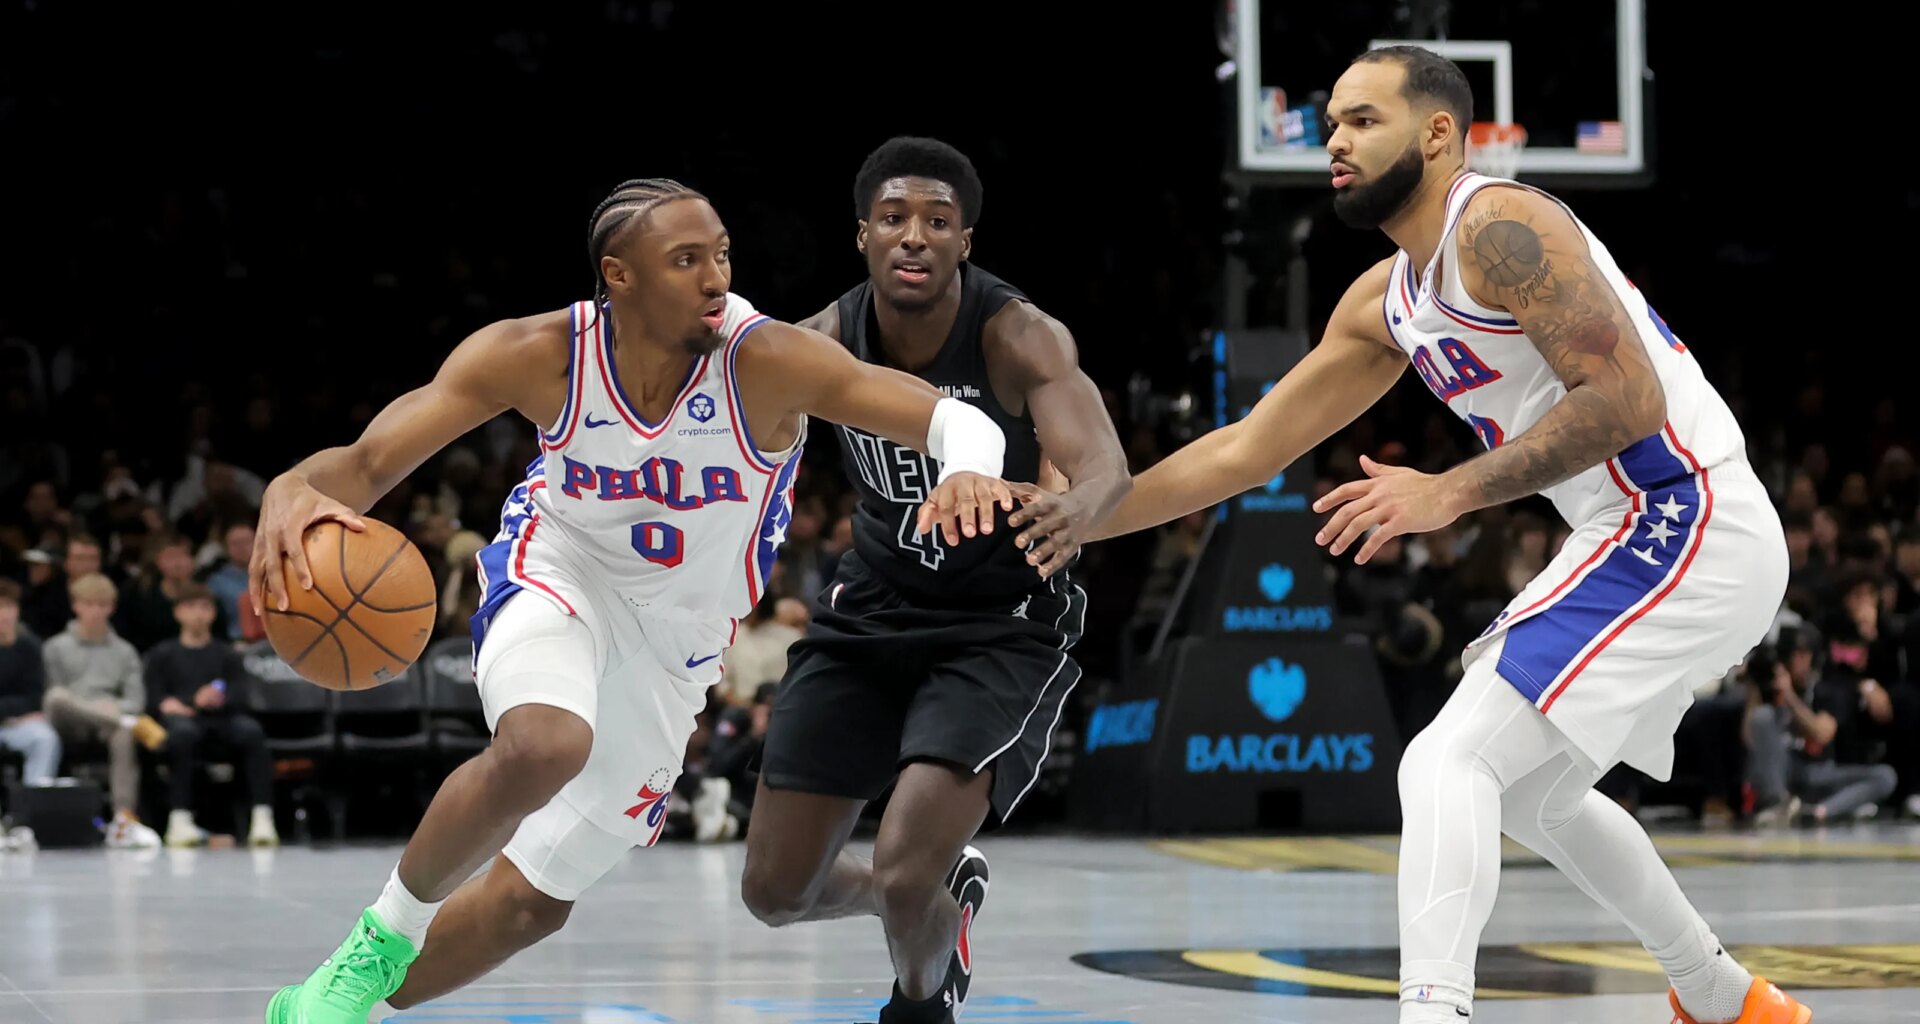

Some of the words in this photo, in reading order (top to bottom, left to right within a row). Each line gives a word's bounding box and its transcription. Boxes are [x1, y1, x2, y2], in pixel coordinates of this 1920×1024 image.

[952, 385, 962, 398] In
[677, 427, 732, 437] crypto.com
[561, 455, 749, 511] PHILA
[630, 521, 685, 569] 0
[897, 504, 945, 571] 4
[1223, 606, 1332, 631] BARCLAYS
[1186, 733, 1374, 773] BARCLAYS
